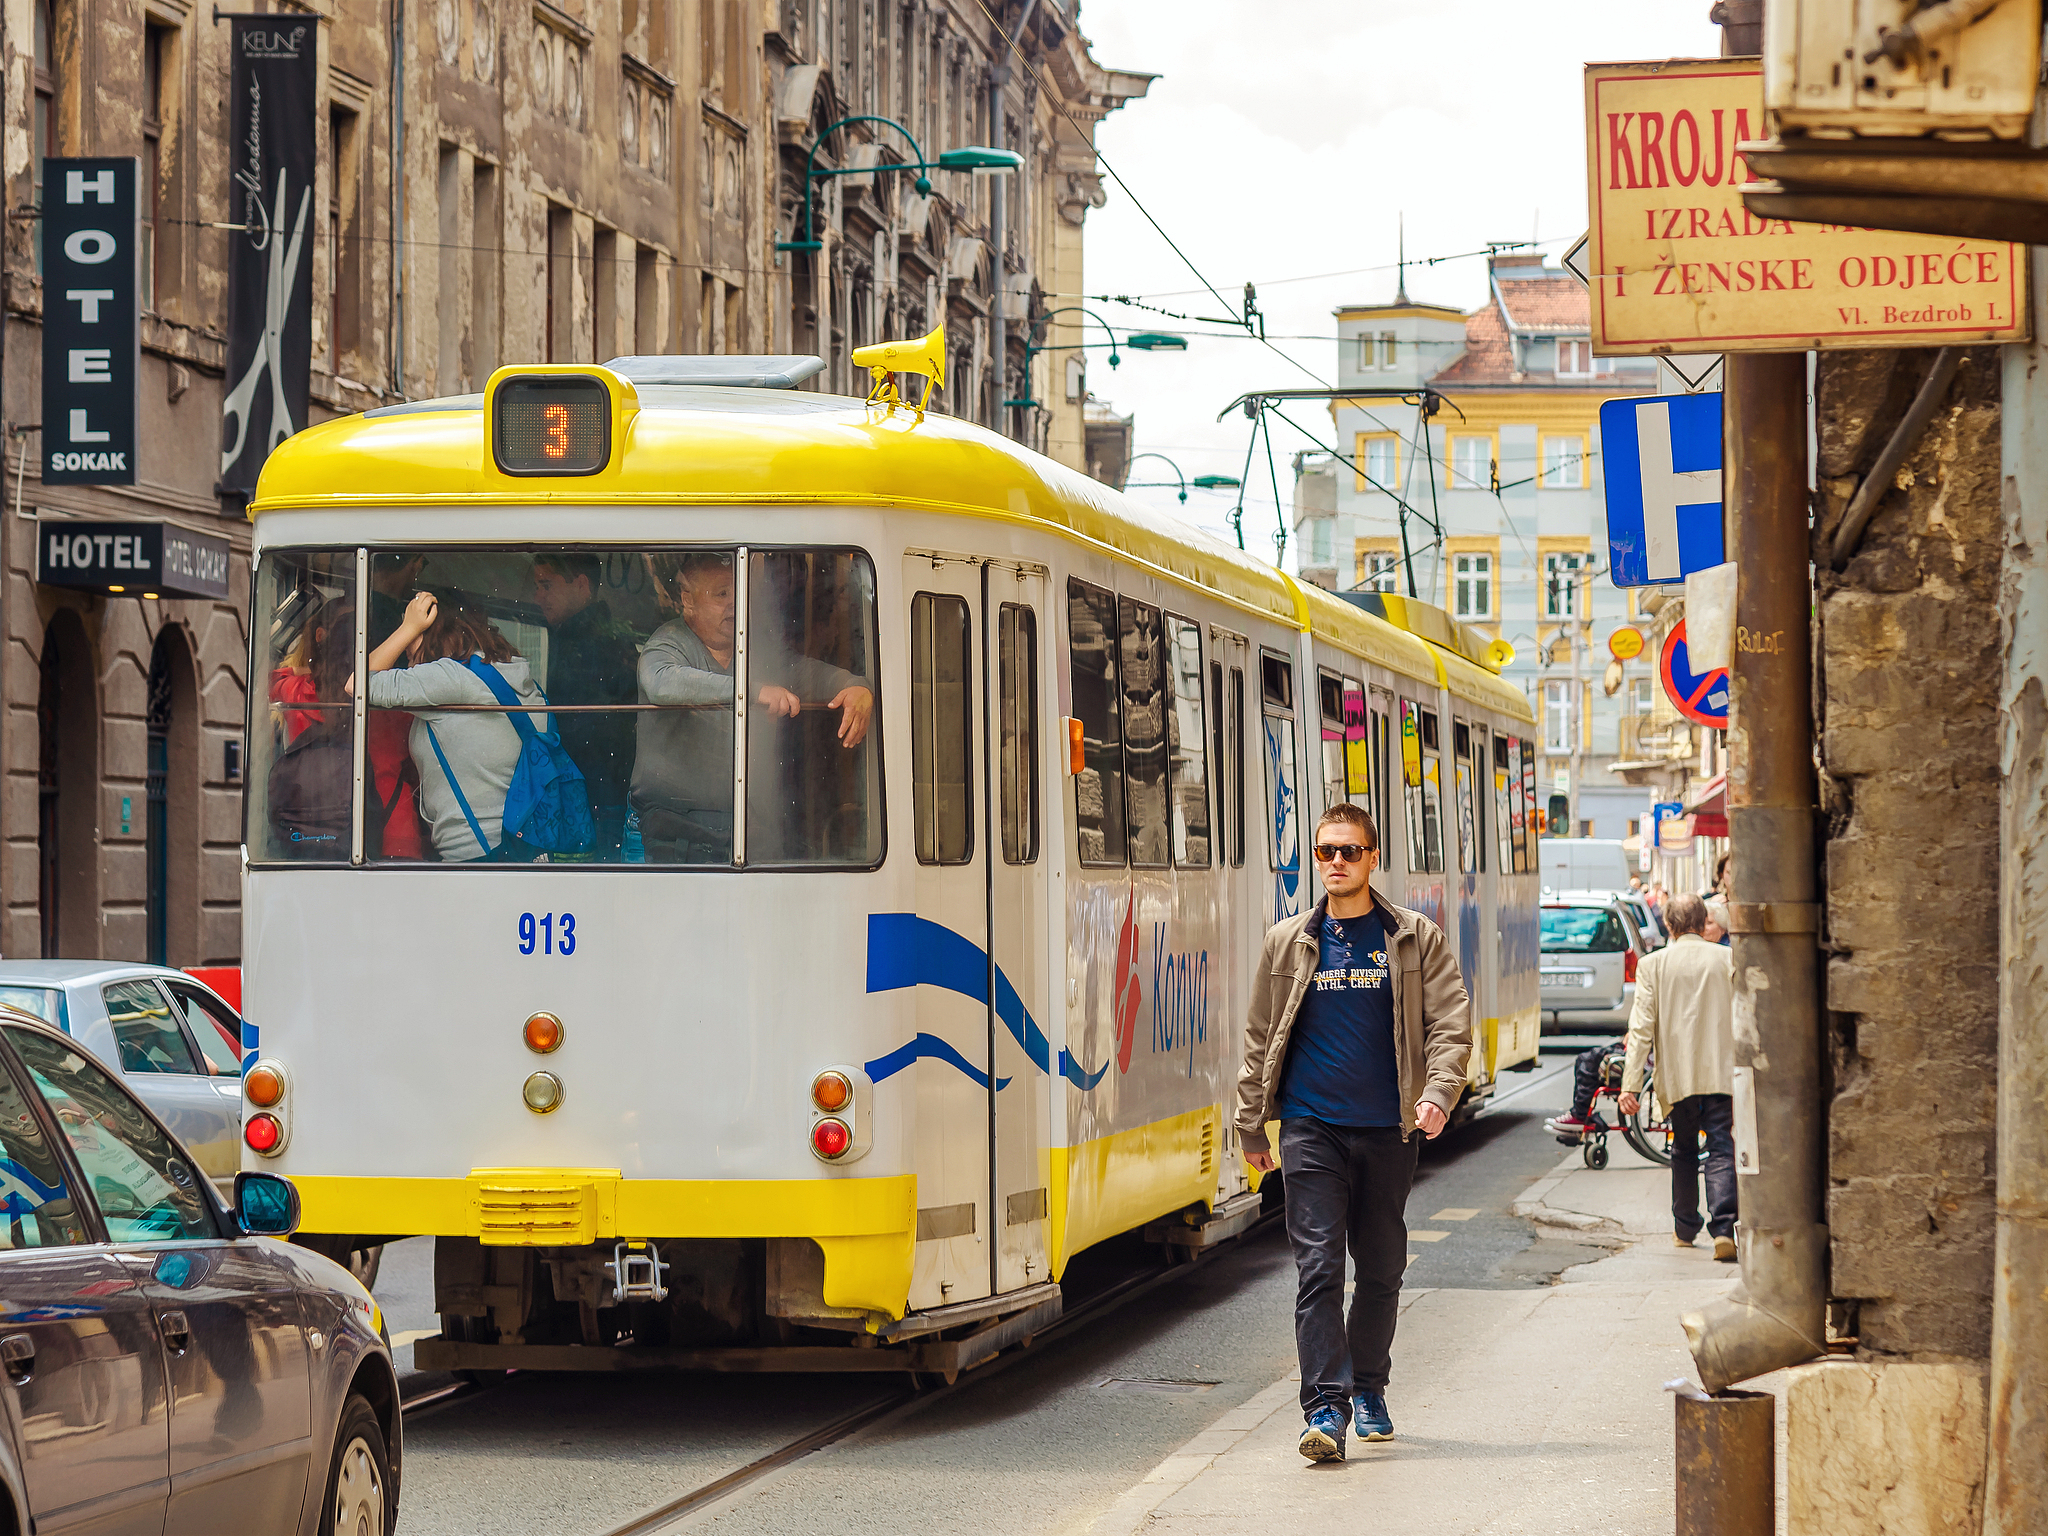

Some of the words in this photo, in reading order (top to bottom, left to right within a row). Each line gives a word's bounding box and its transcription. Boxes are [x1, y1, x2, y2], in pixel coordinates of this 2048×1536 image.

[242, 30, 301, 51] KEUNE
[1607, 108, 1766, 189] KROJA
[1615, 265, 1627, 297] I
[1653, 254, 1814, 296] ŽENSKE
[1838, 242, 2001, 290] ODJEĆE
[64, 169, 117, 442] HOTEL
[1883, 304, 1972, 324] Bezdrob
[546, 406, 568, 456] 3
[51, 452, 127, 471] SOKAK
[49, 534, 151, 570] HOTEL
[518, 911, 577, 956] 913
[1313, 968, 1347, 981] EMIERE
[1350, 968, 1388, 978] DIVISION
[1350, 977, 1382, 989] CREW
[1152, 921, 1208, 1079] Konya
